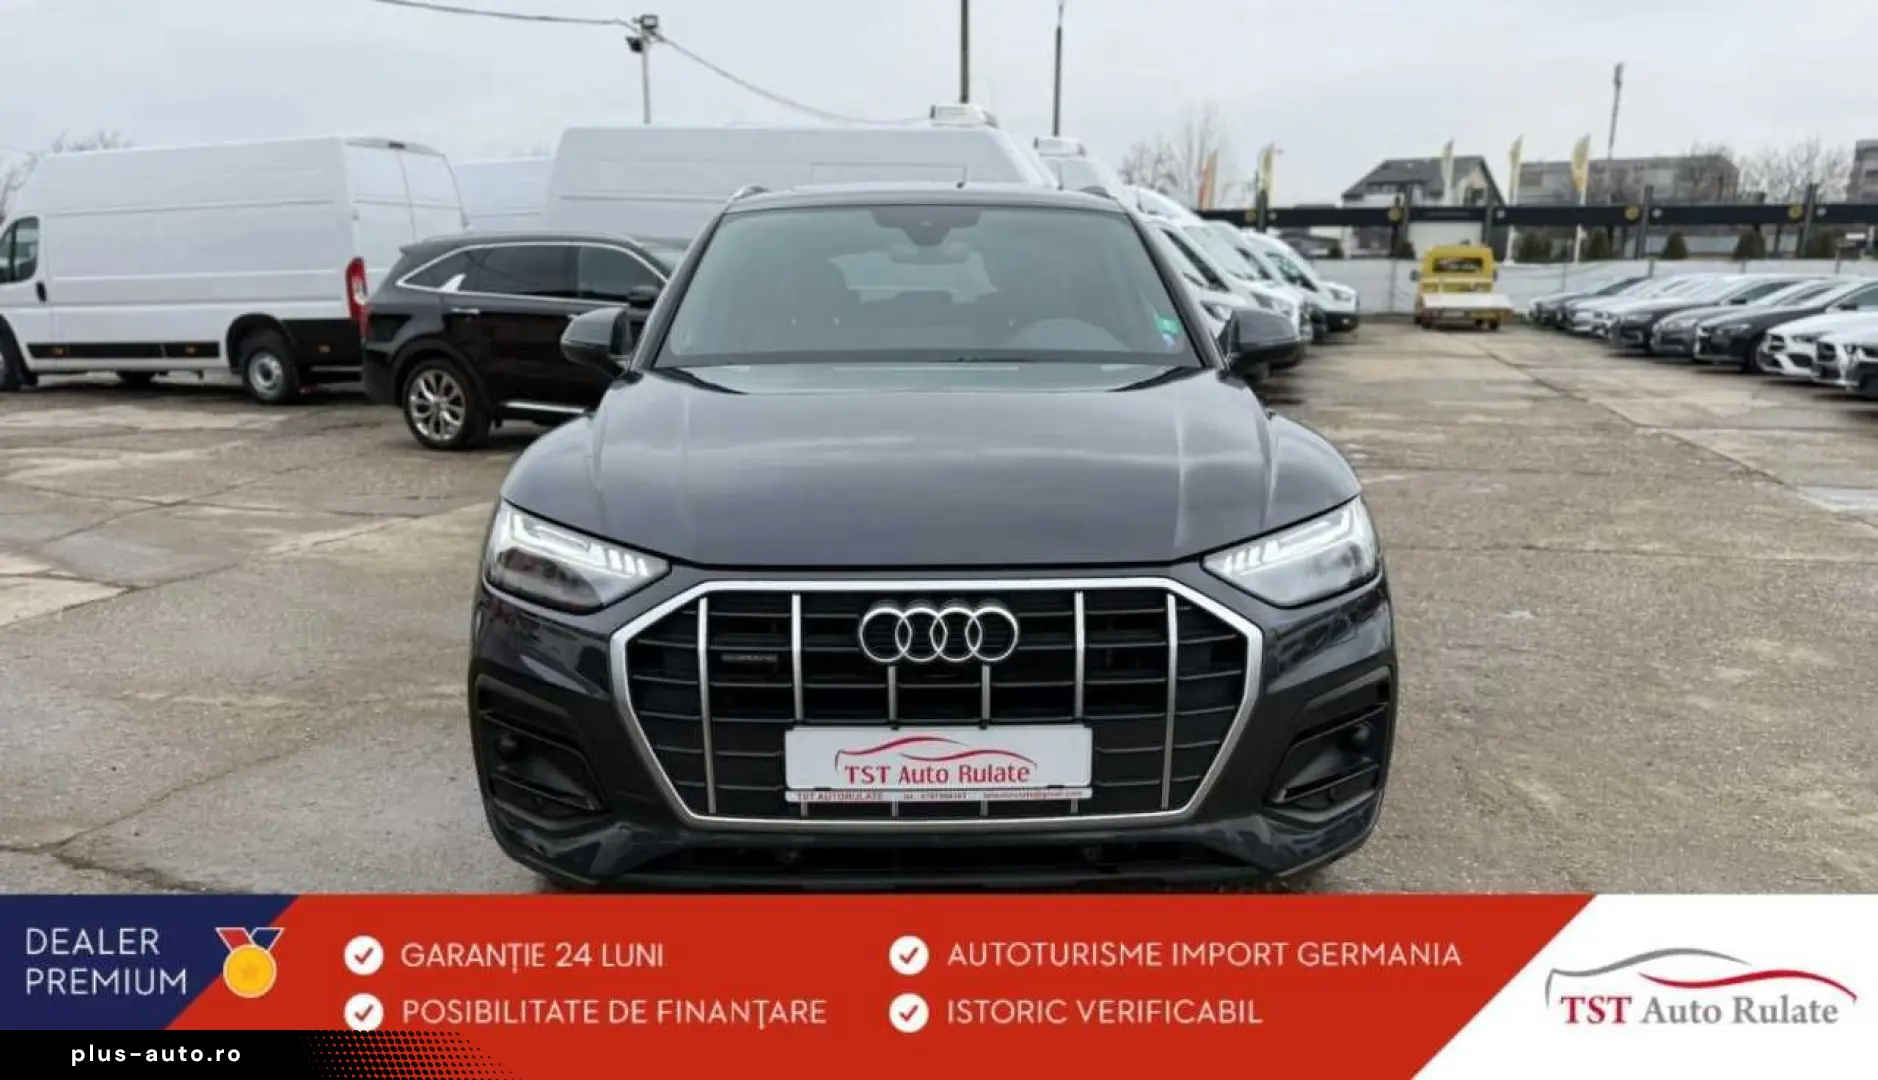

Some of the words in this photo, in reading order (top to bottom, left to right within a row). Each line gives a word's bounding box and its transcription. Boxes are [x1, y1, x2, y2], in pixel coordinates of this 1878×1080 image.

[844, 764, 891, 785] TST
[898, 764, 950, 785] Auto
[958, 763, 1031, 784] Rulate
